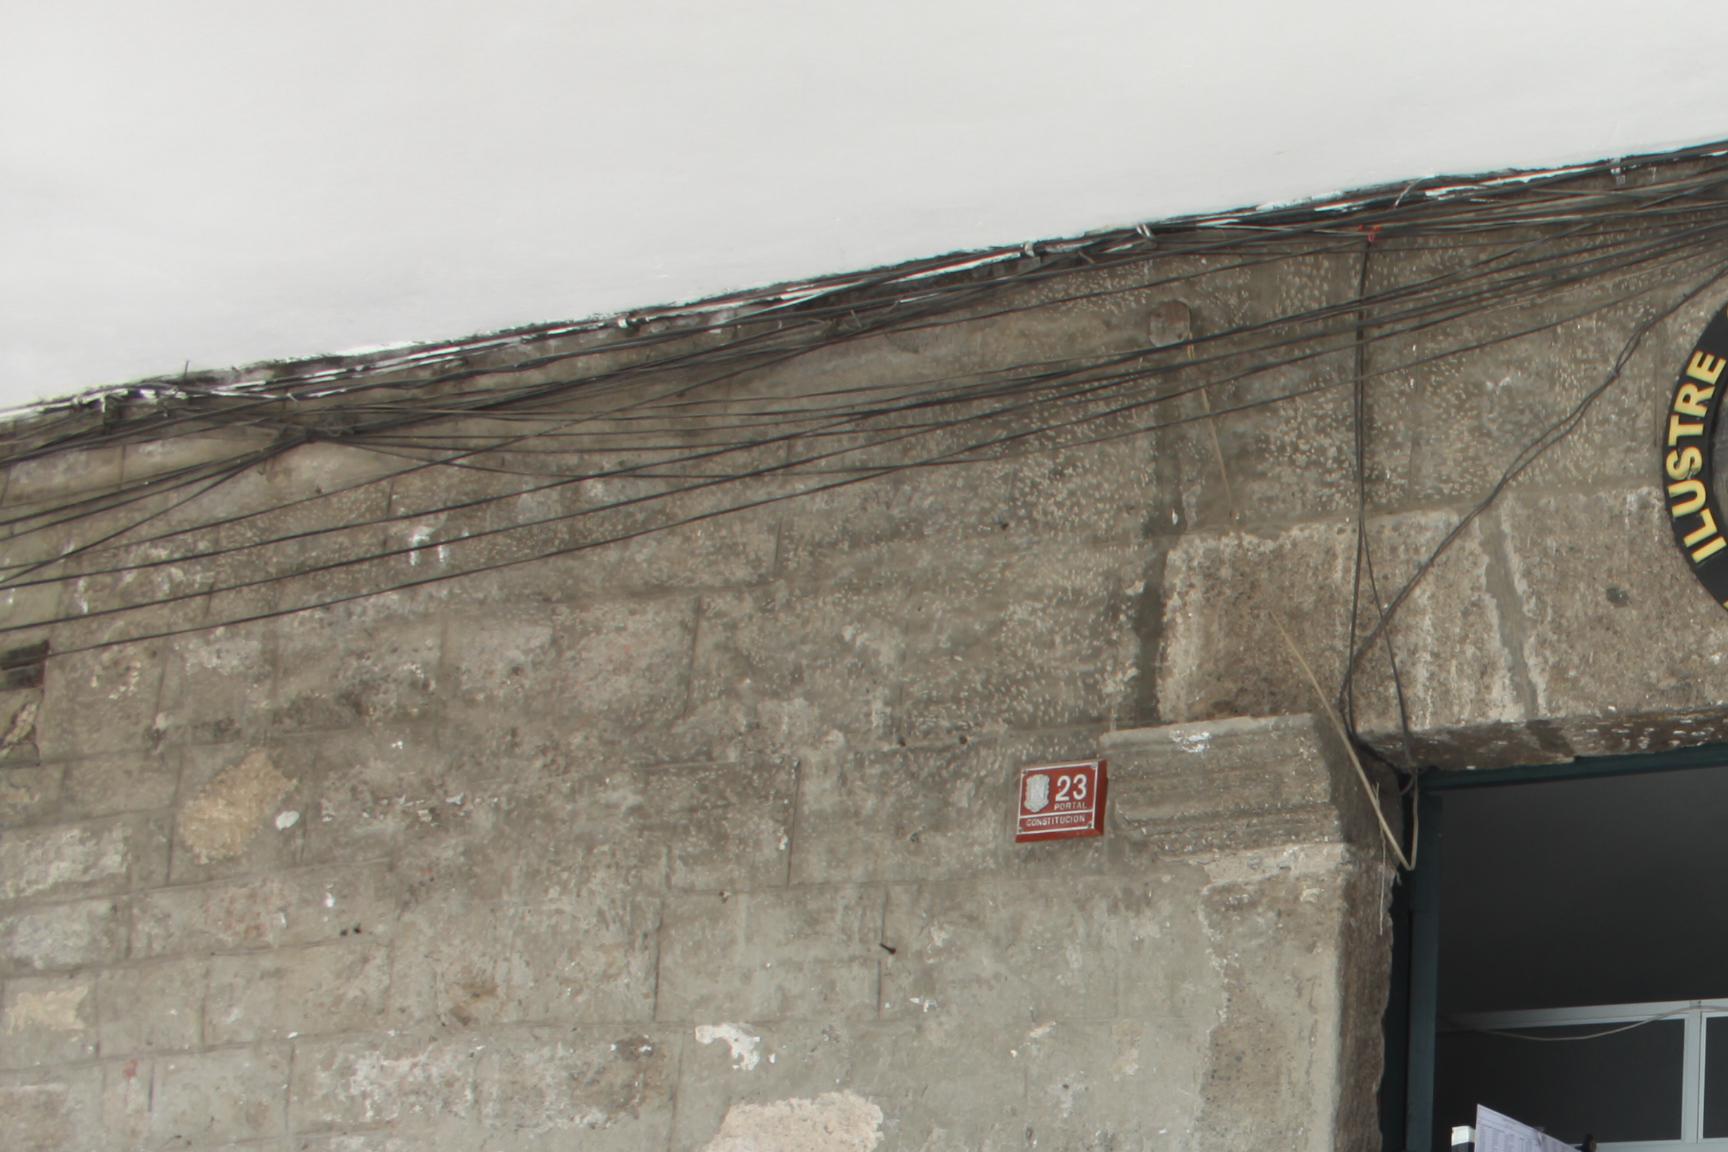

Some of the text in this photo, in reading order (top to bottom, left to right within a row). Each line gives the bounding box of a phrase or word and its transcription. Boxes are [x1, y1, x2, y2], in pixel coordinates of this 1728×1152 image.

[1666, 351, 1727, 563] ILUSTRE
[1055, 773, 1087, 801] 23
[1054, 802, 1088, 811] PORTAL
